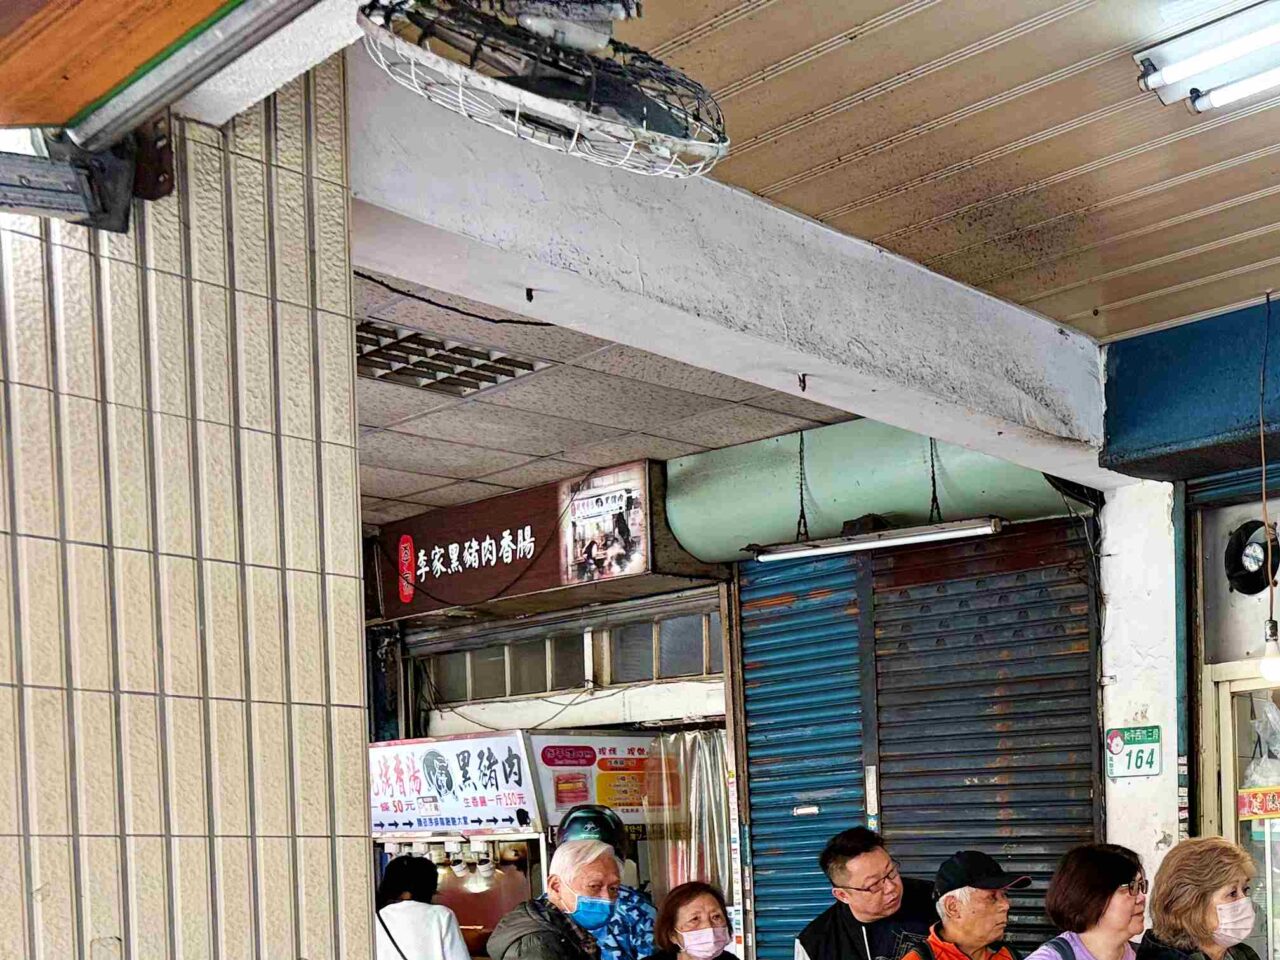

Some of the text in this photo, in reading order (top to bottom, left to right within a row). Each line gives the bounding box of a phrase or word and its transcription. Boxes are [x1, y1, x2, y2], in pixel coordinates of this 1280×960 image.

[415, 525, 536, 584] 李家黑豬肉香腸
[456, 746, 523, 791] 黑豬肉
[1126, 748, 1155, 770] 164
